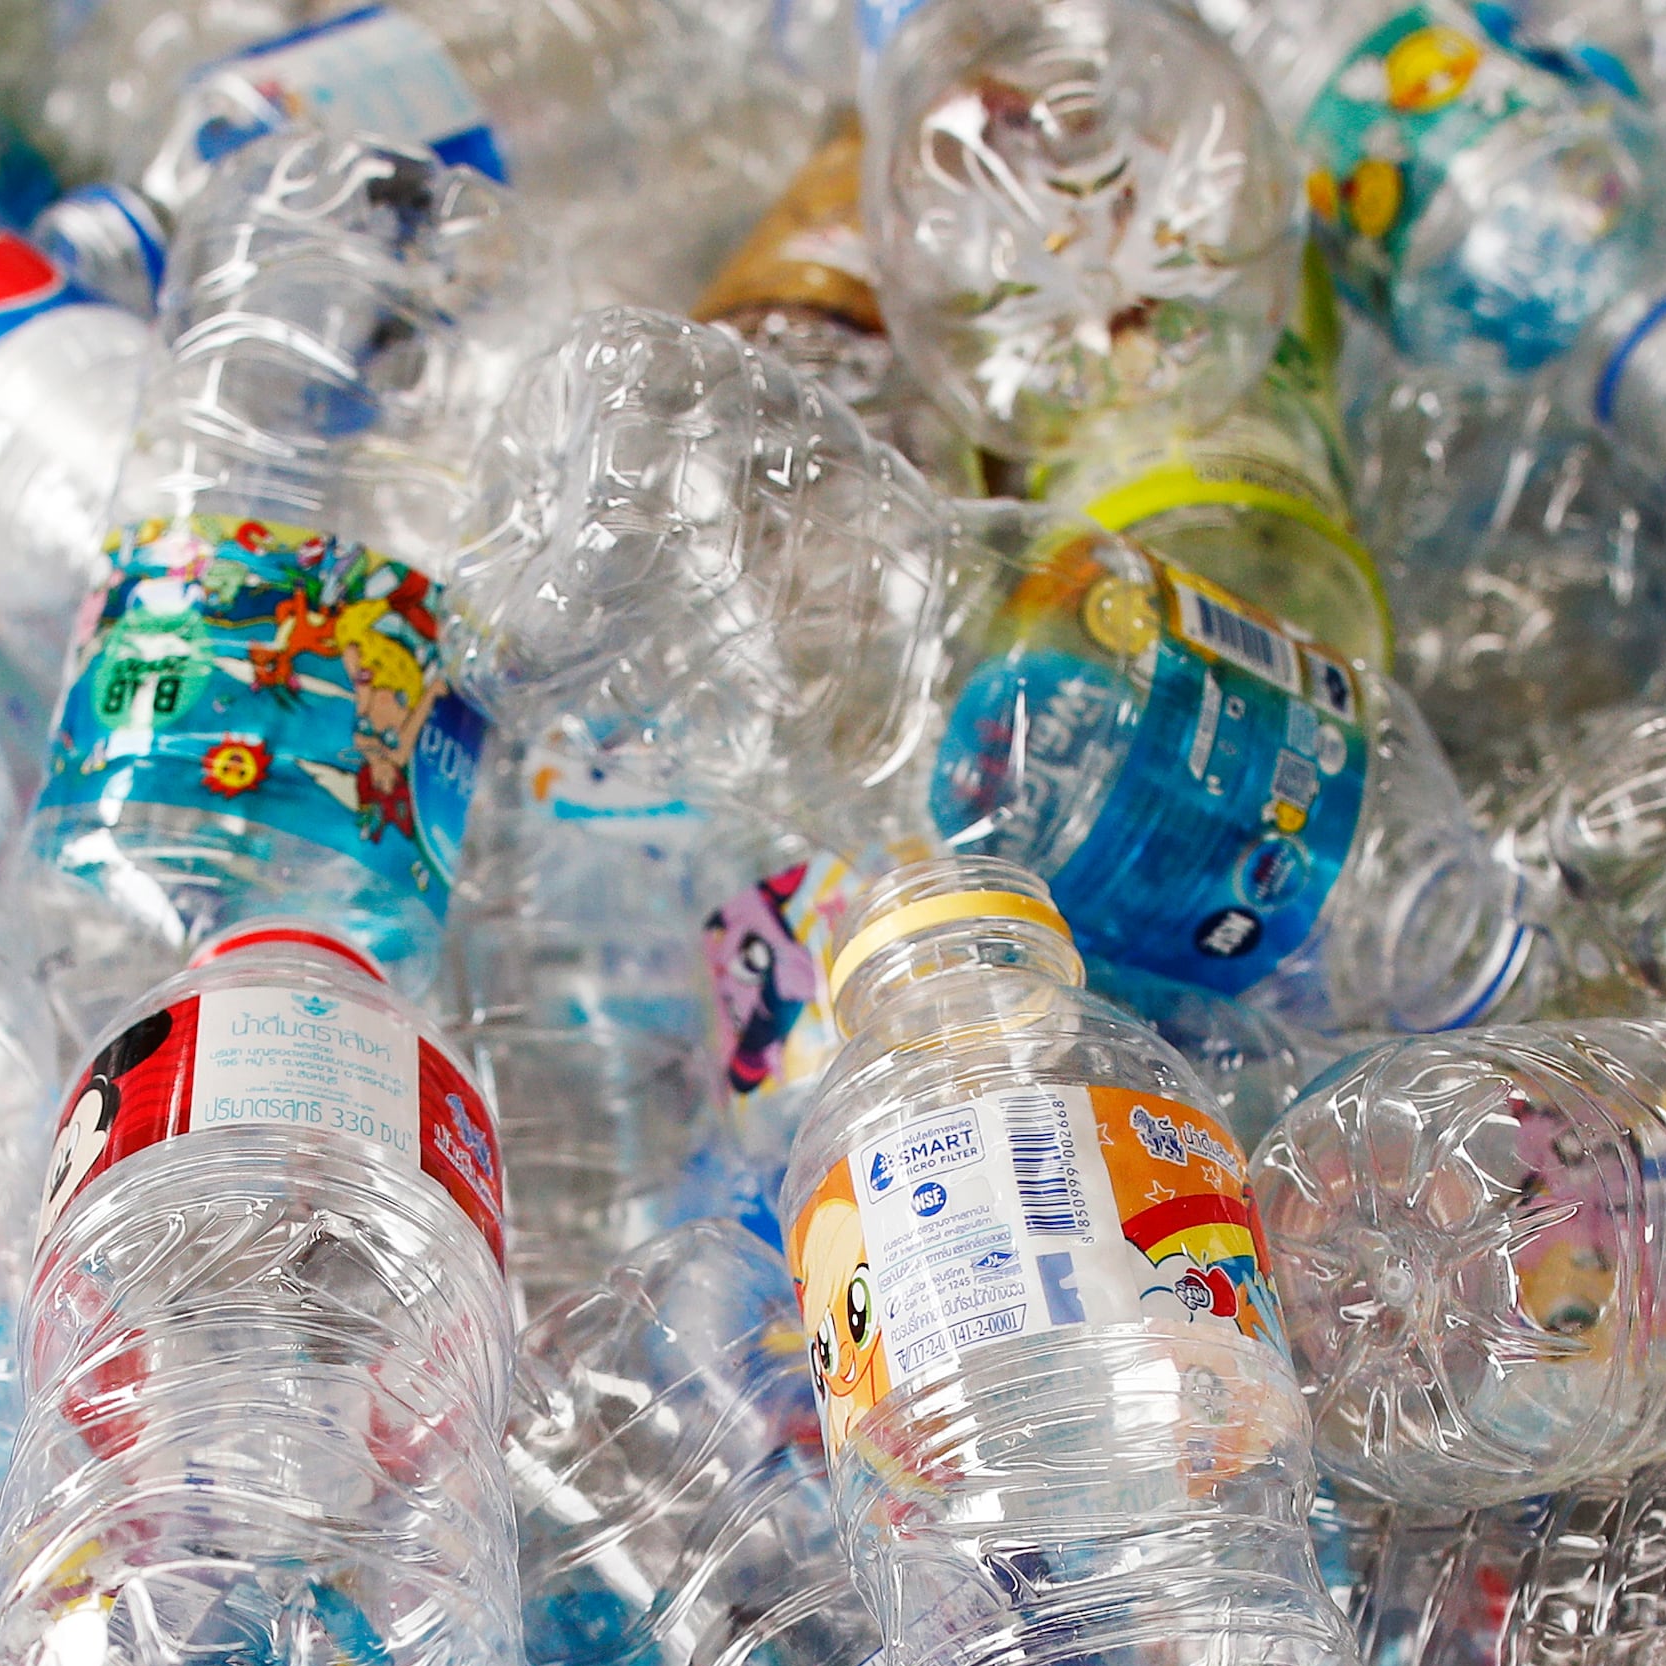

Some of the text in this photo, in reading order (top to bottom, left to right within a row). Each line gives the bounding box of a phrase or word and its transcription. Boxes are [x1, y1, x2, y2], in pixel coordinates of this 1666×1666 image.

[330, 1106, 375, 1138] 330
[1051, 1099, 1076, 1159] 002668
[899, 1129, 974, 1165] SMART
[940, 1147, 978, 1168] FILTER
[1066, 1166, 1091, 1229] 850999
[948, 1276, 972, 1292] 1245
[912, 1310, 1018, 1363] 17-2-0141-2-0001
